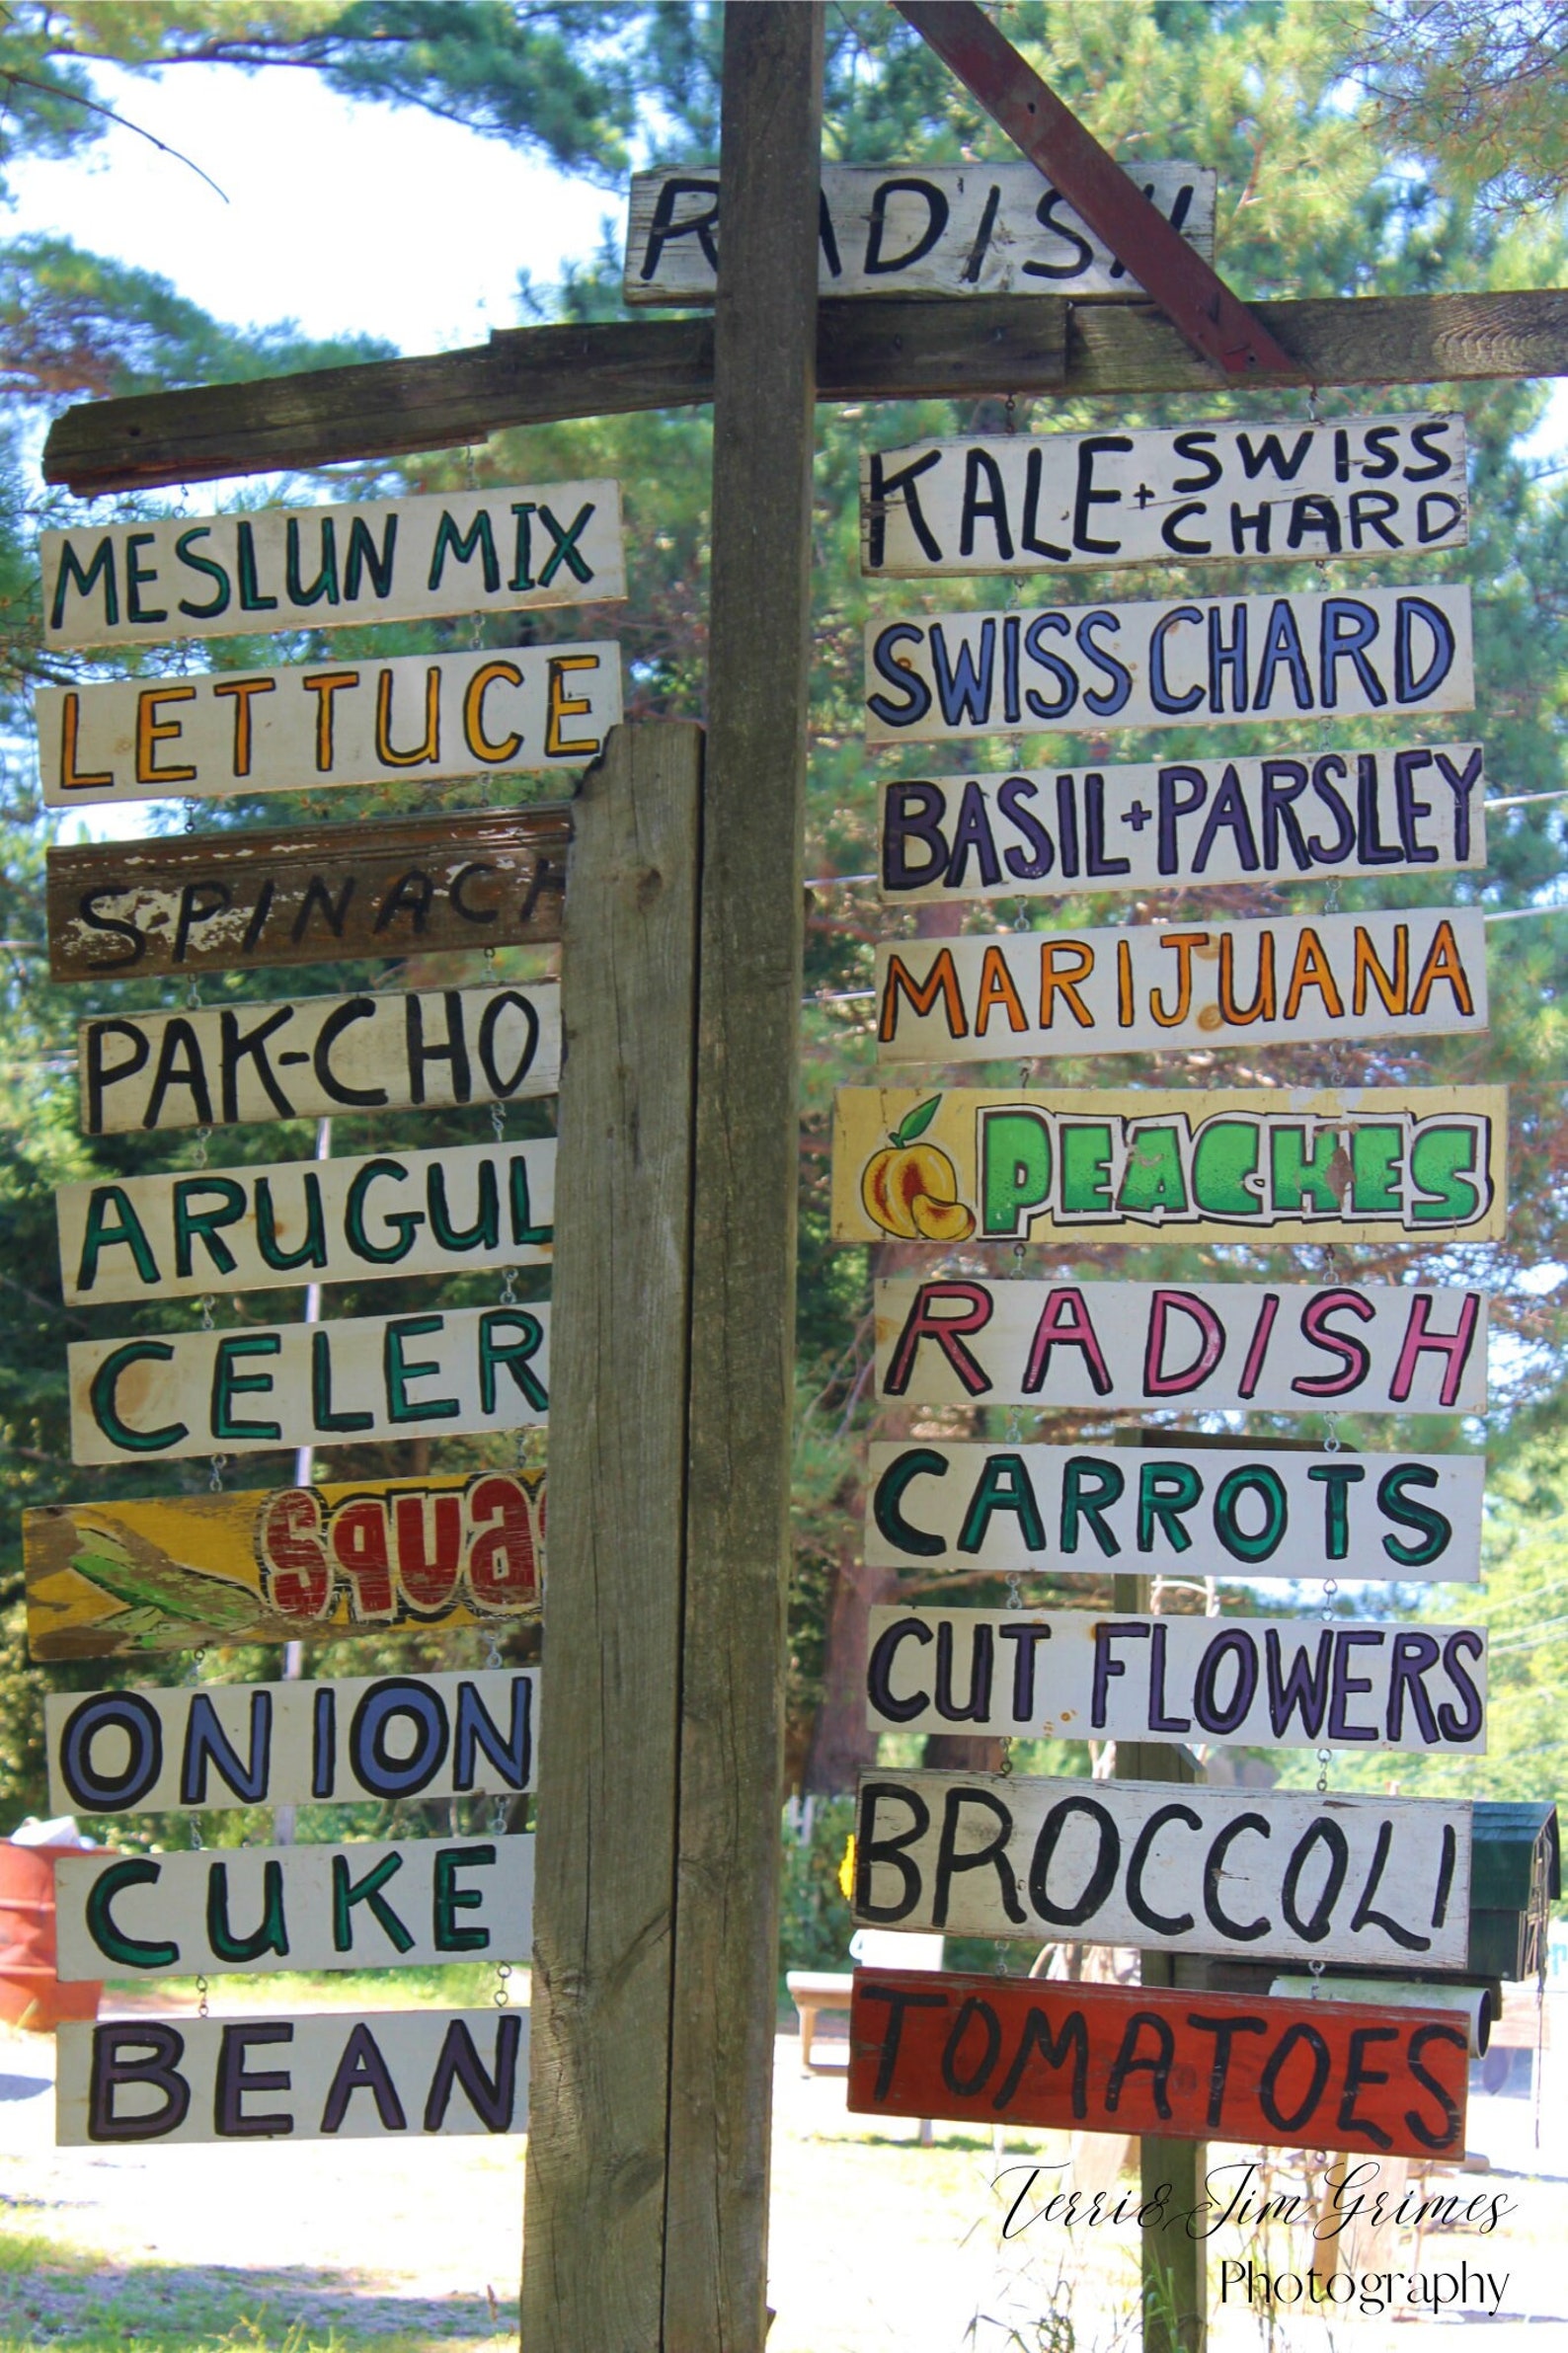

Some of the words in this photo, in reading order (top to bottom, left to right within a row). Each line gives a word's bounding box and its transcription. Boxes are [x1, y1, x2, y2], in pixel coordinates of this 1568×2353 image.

[1172, 422, 1453, 493] SWISS
[50, 513, 398, 629] MESLUN
[429, 503, 596, 592] MIX
[1161, 490, 1462, 555] CHARD
[61, 655, 600, 789] LETTUCE
[867, 609, 1132, 727] SWISS
[1149, 596, 1455, 715] CHARD
[878, 920, 1474, 1042] MARIJUANA
[977, 1104, 1494, 1241] PEACHES
[90, 1308, 550, 1451] CELER
[884, 1281, 1479, 1406] RADISH
[873, 1449, 1452, 1566] CARROTS
[60, 1676, 533, 1812] ONION
[867, 1616, 1052, 1722] CUT
[1091, 1621, 1483, 1744] FLOWERS
[86, 1844, 497, 1968] CUKE
[856, 1782, 1456, 1951] BROCCOLI
[88, 2015, 522, 2143] BEAN
[860, 1985, 1466, 2151] TOMATOES
